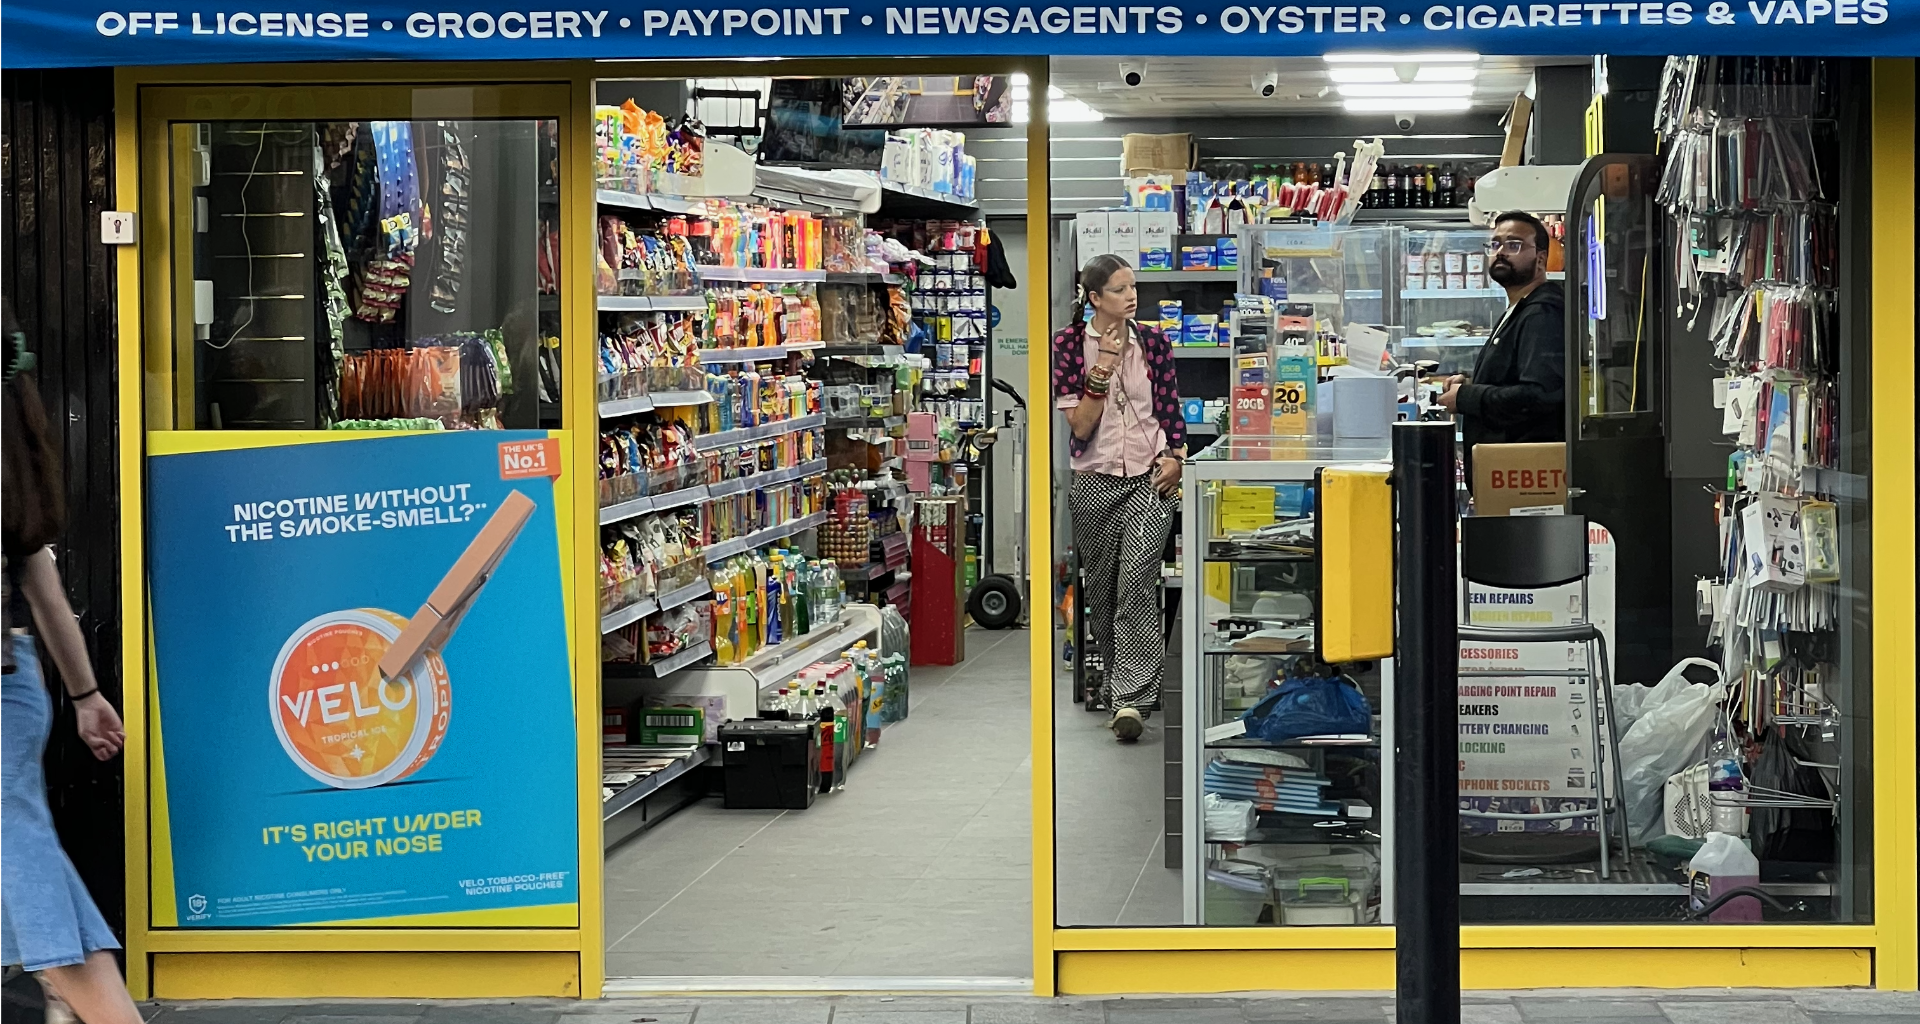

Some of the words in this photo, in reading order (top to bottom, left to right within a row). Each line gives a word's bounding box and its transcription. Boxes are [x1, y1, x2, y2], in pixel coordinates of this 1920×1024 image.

[96, 12, 178, 36] OFF
[192, 13, 368, 37] LICENSE
[406, 11, 608, 38] GROCERY
[644, 8, 849, 36] PAYPOINT
[886, 7, 1182, 34] NEWSAGENTS
[1221, 6, 1386, 33] OYSTER
[1424, 2, 1692, 30] CIGARETTES
[1706, 2, 1735, 24] &
[1749, 0, 1888, 24] VAPES
[1236, 398, 1265, 410] 20GB
[1275, 388, 1300, 403] 20
[1281, 403, 1299, 414] GB
[523, 443, 544, 452] UK'S
[504, 451, 546, 470] No.1
[233, 494, 348, 521] NICOTINE
[354, 483, 471, 510] WITHOUT
[225, 524, 273, 543] THE
[1489, 593, 1534, 604] REPAIRS
[1495, 686, 1522, 697] POINT
[1524, 686, 1557, 697] REPAIR
[281, 676, 413, 728] VELO
[321, 729, 369, 744] TROPICAL
[1493, 724, 1549, 735] CHANGING
[1502, 779, 1550, 791] SOCKETS
[262, 824, 308, 845] IT'S
[314, 817, 387, 841] RIGHT
[393, 809, 482, 834] UNDER
[301, 842, 369, 862] YOUR
[376, 833, 443, 855] NOSE
[458, 878, 485, 888] VELO
[465, 885, 513, 896] NICOTINE
[515, 880, 563, 892] POUCHES
